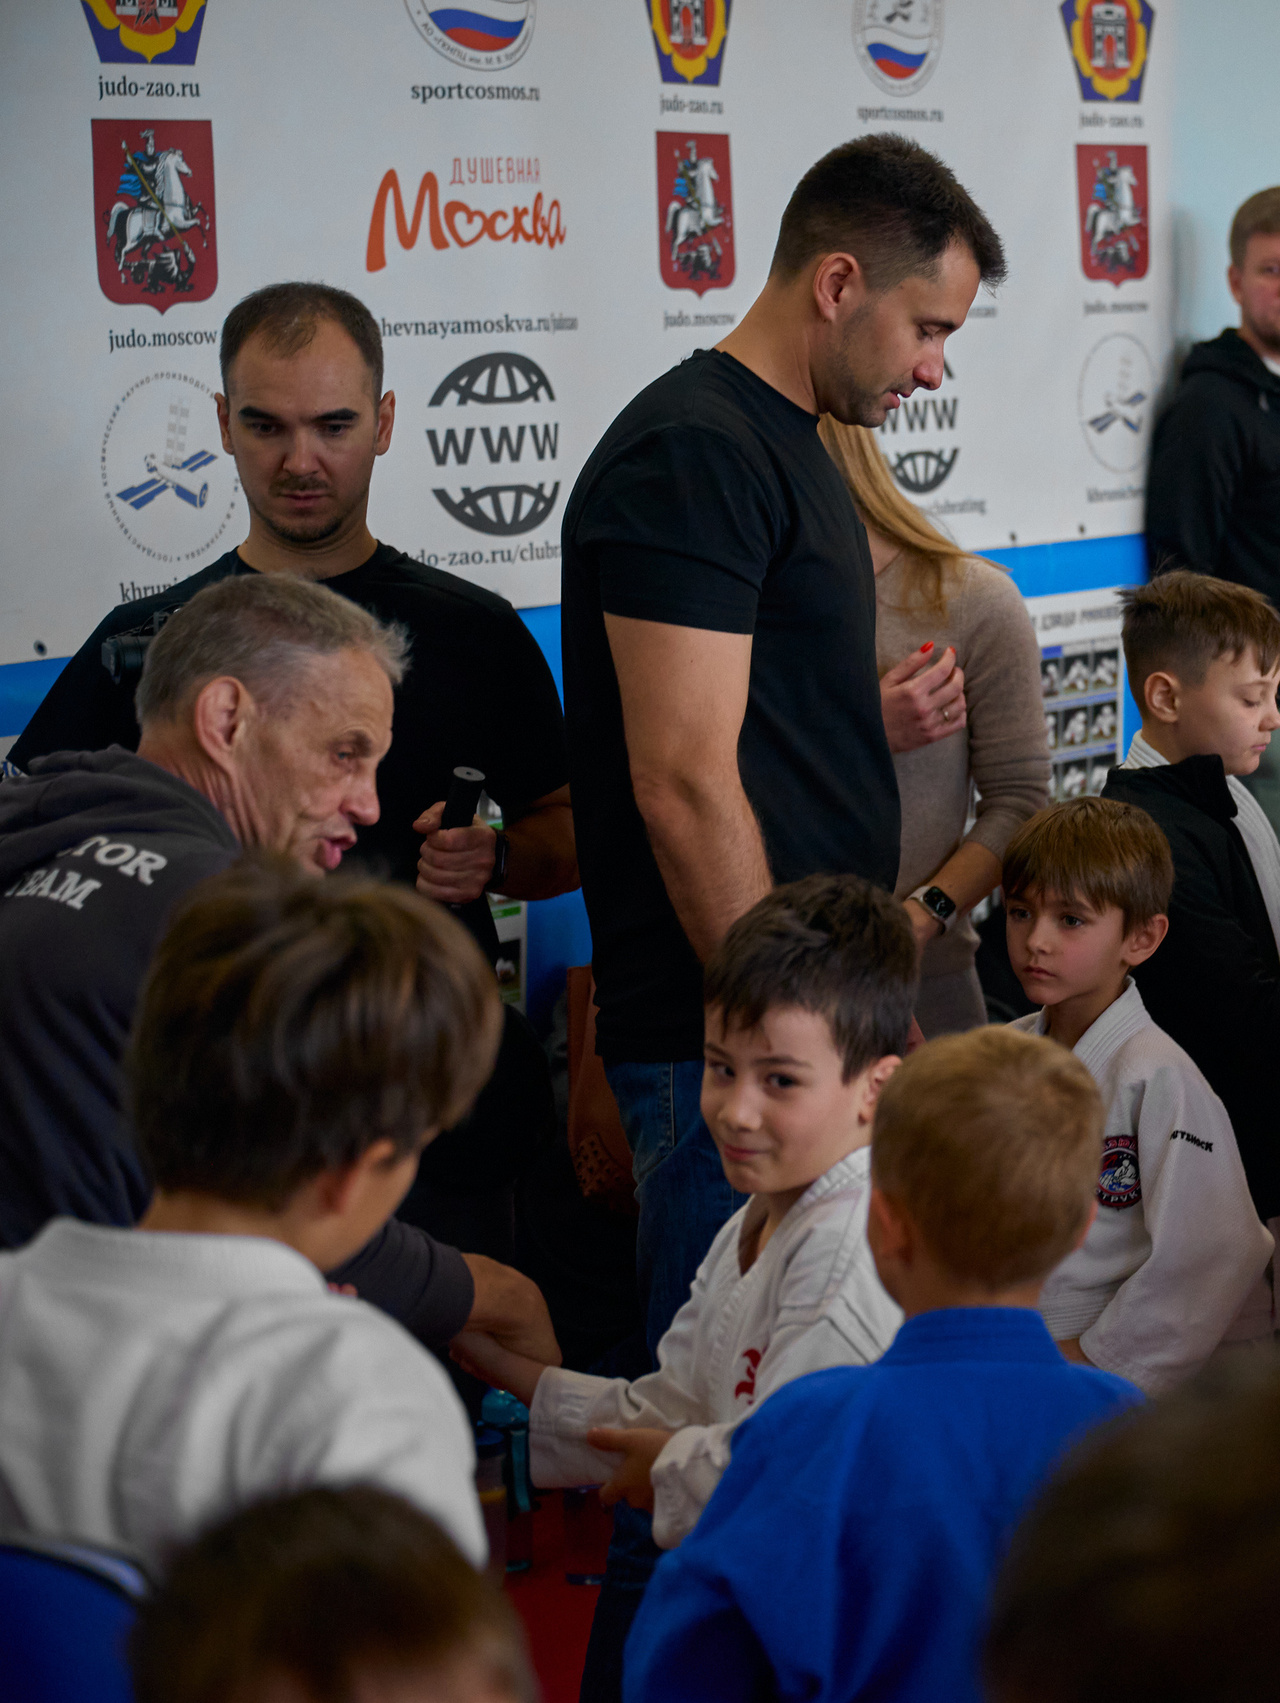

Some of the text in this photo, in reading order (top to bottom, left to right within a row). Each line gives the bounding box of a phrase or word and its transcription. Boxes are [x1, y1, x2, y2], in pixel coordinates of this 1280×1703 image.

[98, 75, 200, 101] judo-zao.ru
[411, 83, 541, 104] sportcosmos.ru
[450, 157, 541, 186] ДУШЕВНАЯ
[366, 168, 567, 273] Москва
[109, 328, 217, 353] judo.moscow
[425, 423, 558, 466] WWW
